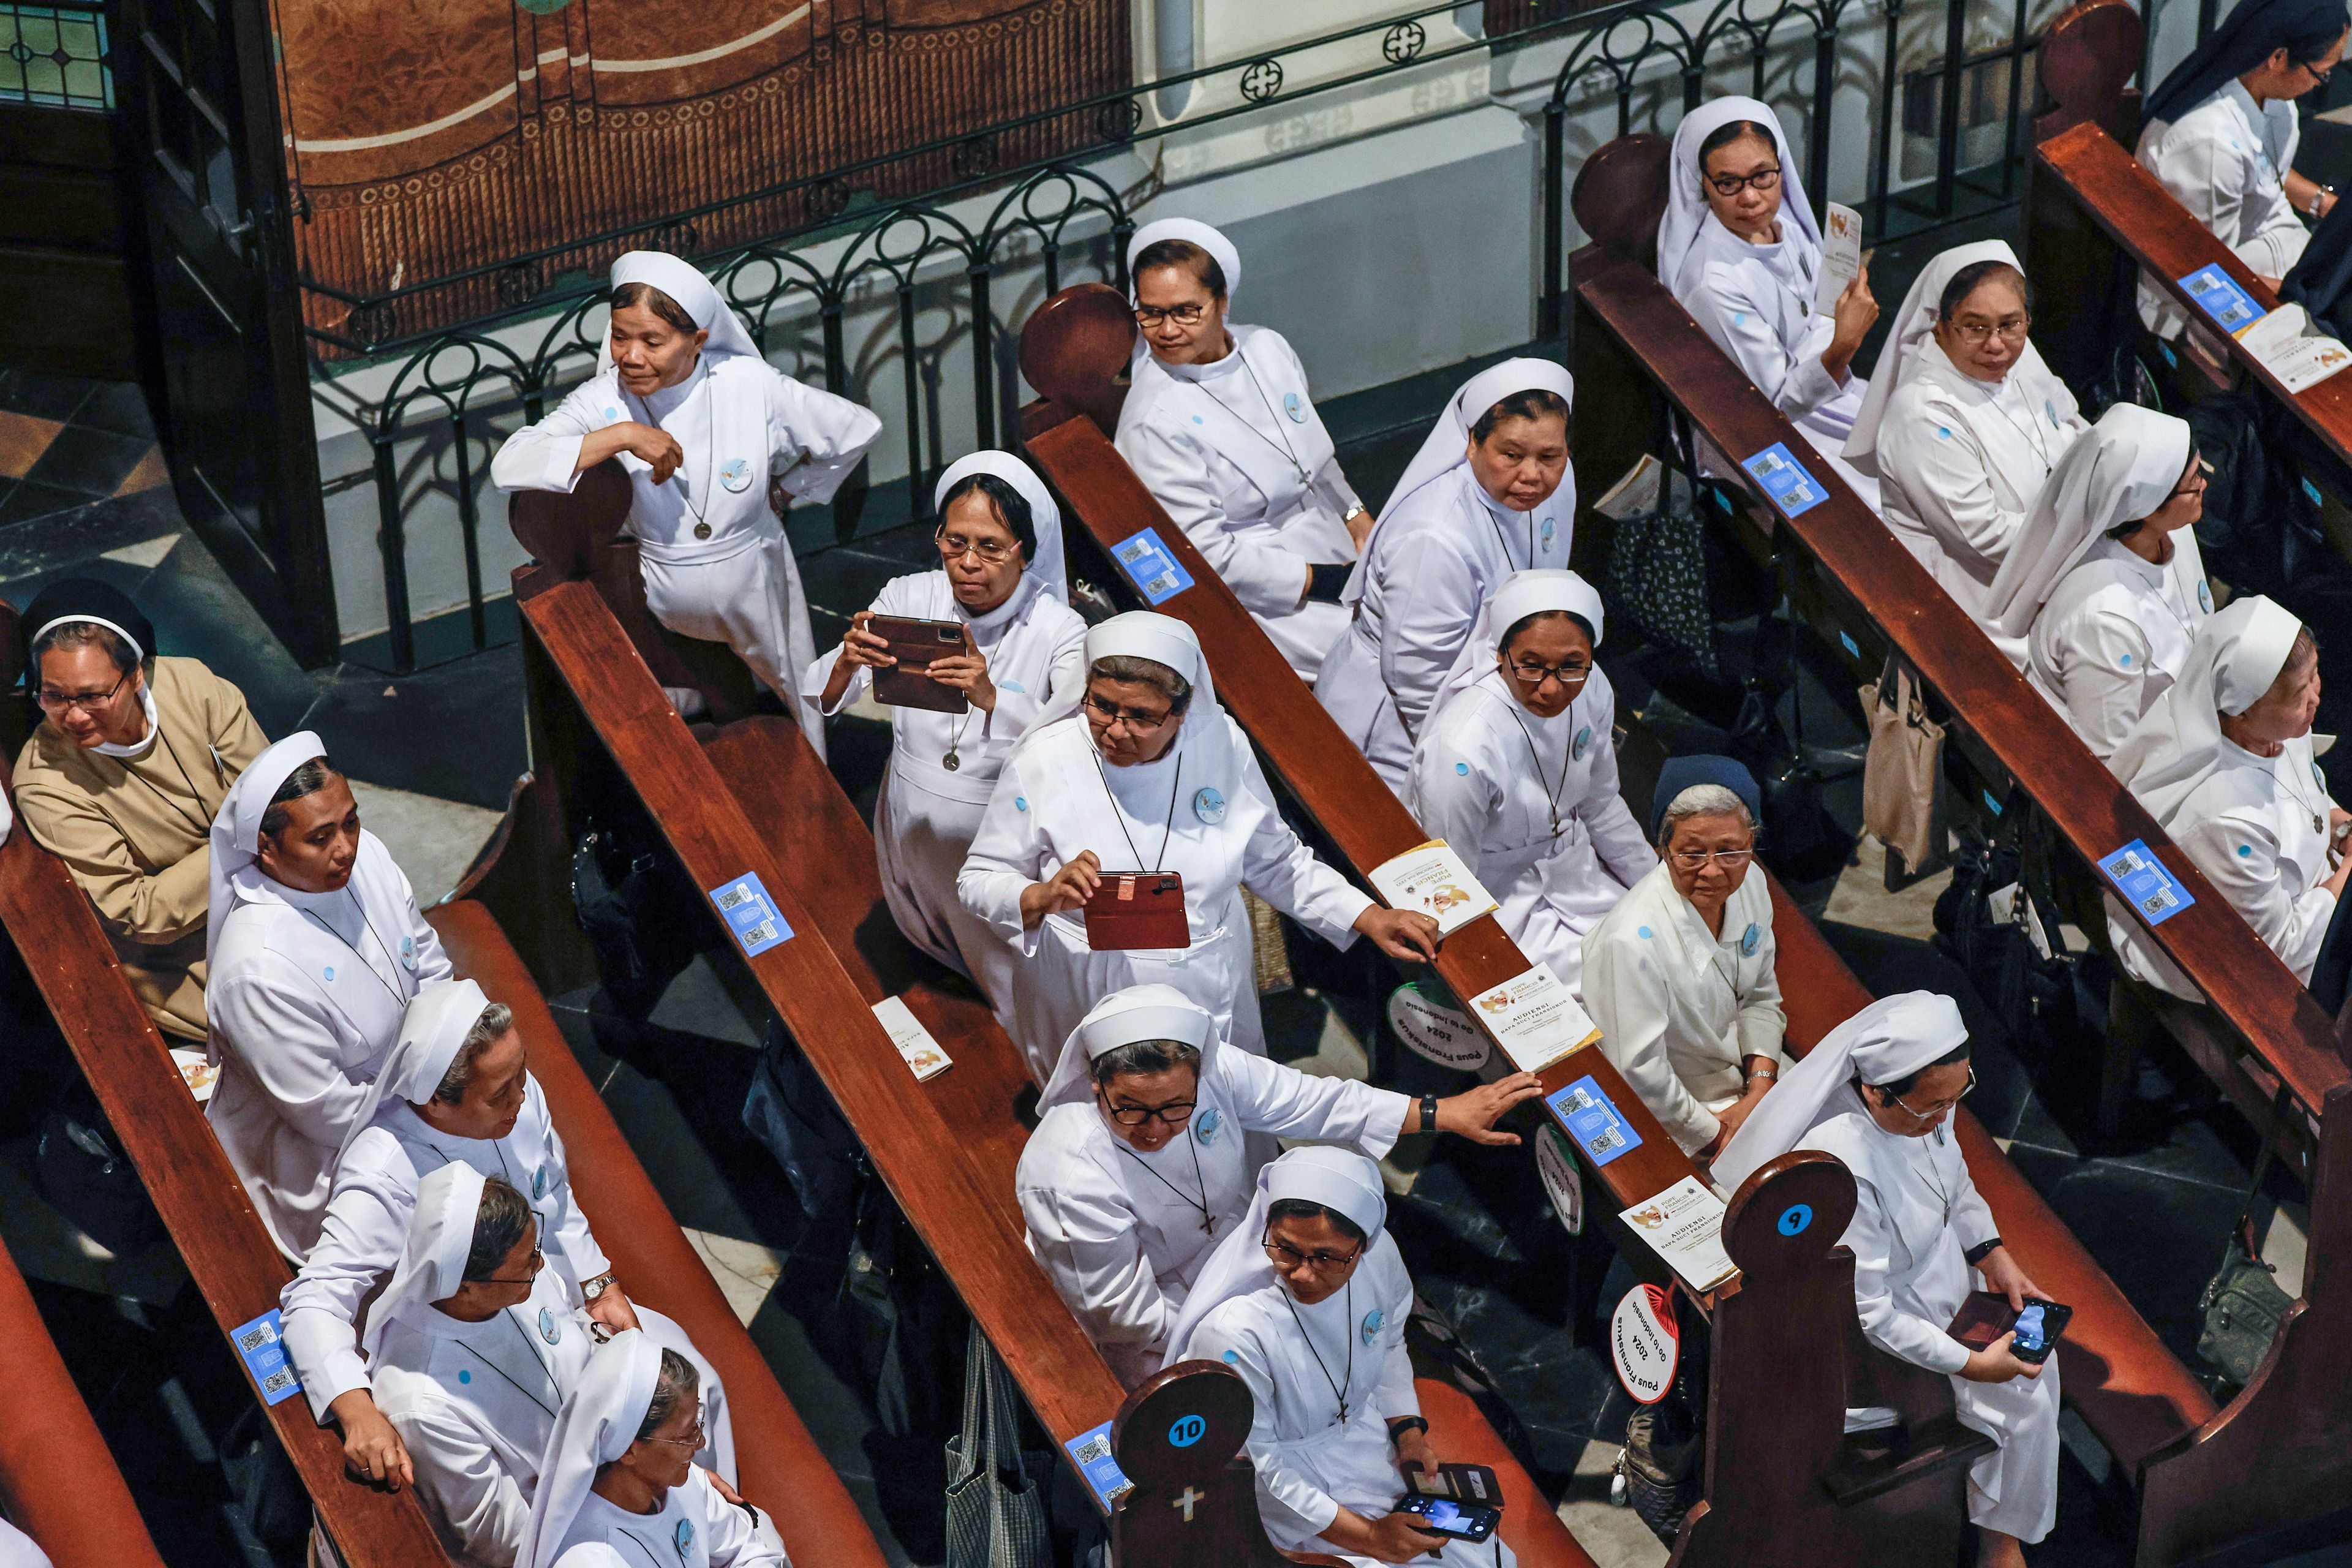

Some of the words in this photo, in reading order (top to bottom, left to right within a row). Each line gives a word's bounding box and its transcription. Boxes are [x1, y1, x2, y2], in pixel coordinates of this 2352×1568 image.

[1415, 869, 1449, 886] FRANCIS
[1431, 873, 1452, 885] POPE
[1406, 1001, 1448, 1024] Indonesia
[1512, 1003, 1549, 1022] AUDIENSI
[1517, 1017, 1531, 1025] SUCI
[1398, 1019, 1454, 1061] Fransiskus
[1426, 1025, 1452, 1042] 2024
[1456, 1050, 1482, 1061] Paus
[1660, 1196, 1677, 1206] POPE
[1665, 1194, 1689, 1210] FRANCIS
[1671, 1216, 1706, 1238] AUDIENSI
[1788, 1212, 1801, 1229] 9
[1660, 1240, 1676, 1250] BAPA
[1676, 1232, 1690, 1241] SUCI
[1691, 1211, 1724, 1234] FRANSISKUS
[1632, 1301, 1654, 1341] Indonesia
[1617, 1316, 1637, 1383] Fransiskus
[1632, 1335, 1648, 1361] 2024
[1653, 1339, 1659, 1350] to
[1659, 1348, 1666, 1362] Go
[1638, 1378, 1658, 1391] Paus
[1174, 1420, 1200, 1441] 10
